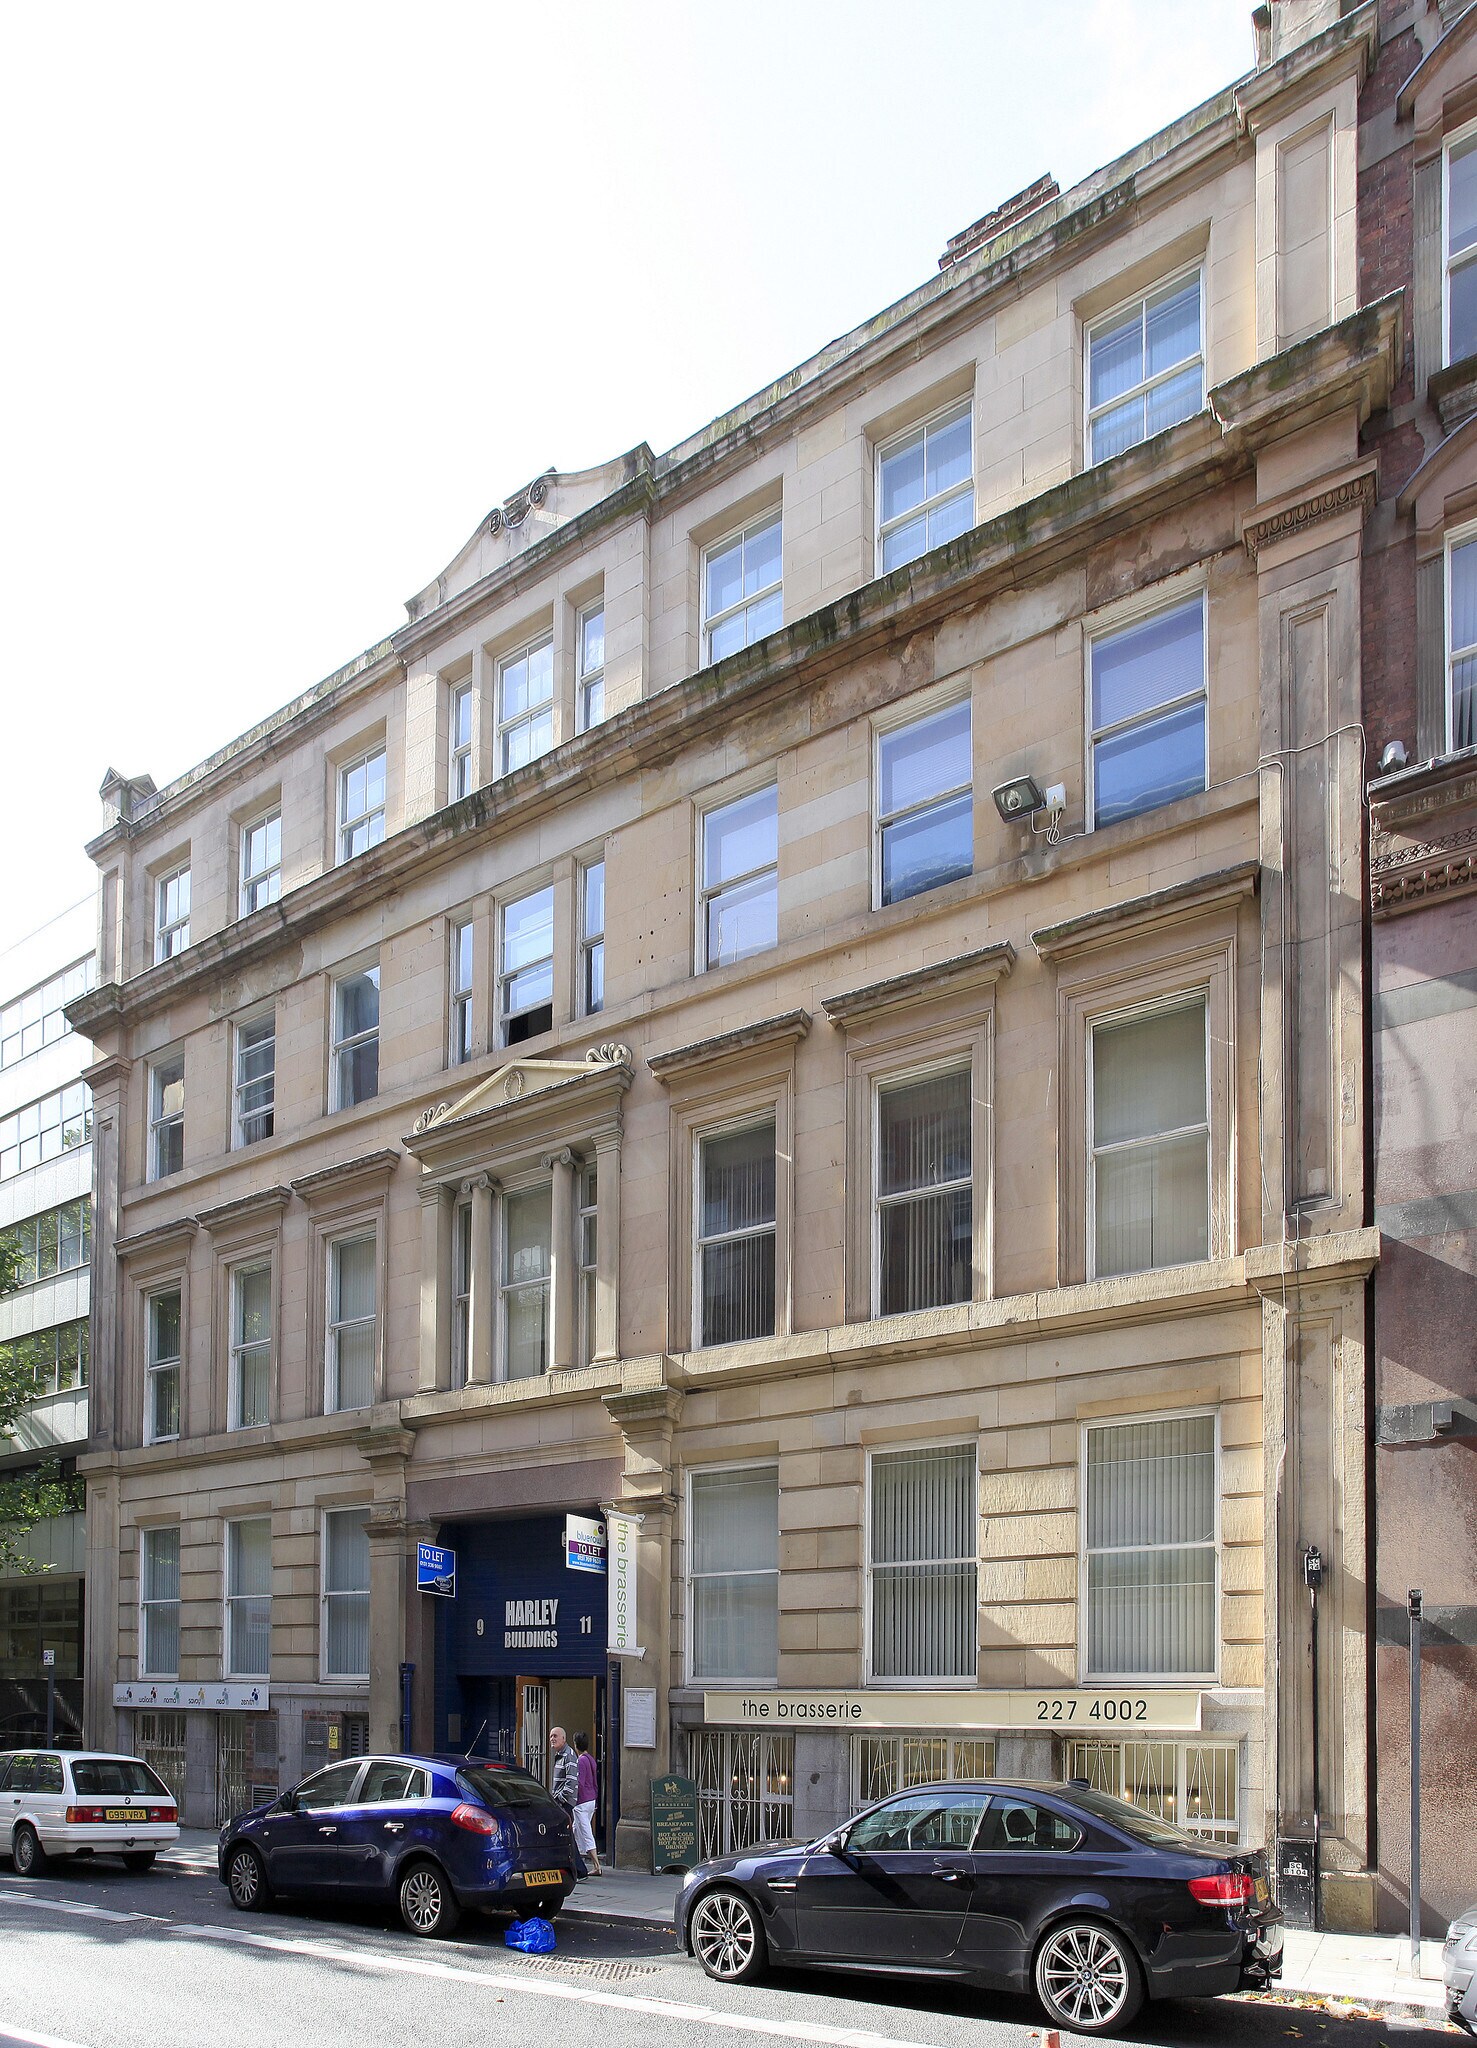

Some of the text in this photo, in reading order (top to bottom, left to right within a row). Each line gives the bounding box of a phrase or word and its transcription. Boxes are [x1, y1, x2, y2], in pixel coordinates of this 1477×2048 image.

[420, 1547, 444, 1563] TO LET
[577, 1543, 601, 1557] TO LET
[616, 1522, 629, 1648] the brasserie
[505, 1599, 558, 1626] HARLEY
[476, 1619, 484, 1636] 9
[579, 1616, 592, 1634] 11
[504, 1631, 558, 1648] BUILDINGS
[742, 1699, 862, 1719] the brasserie
[1037, 1700, 1148, 1720] 227 4002
[128, 1810, 144, 1819] VRX
